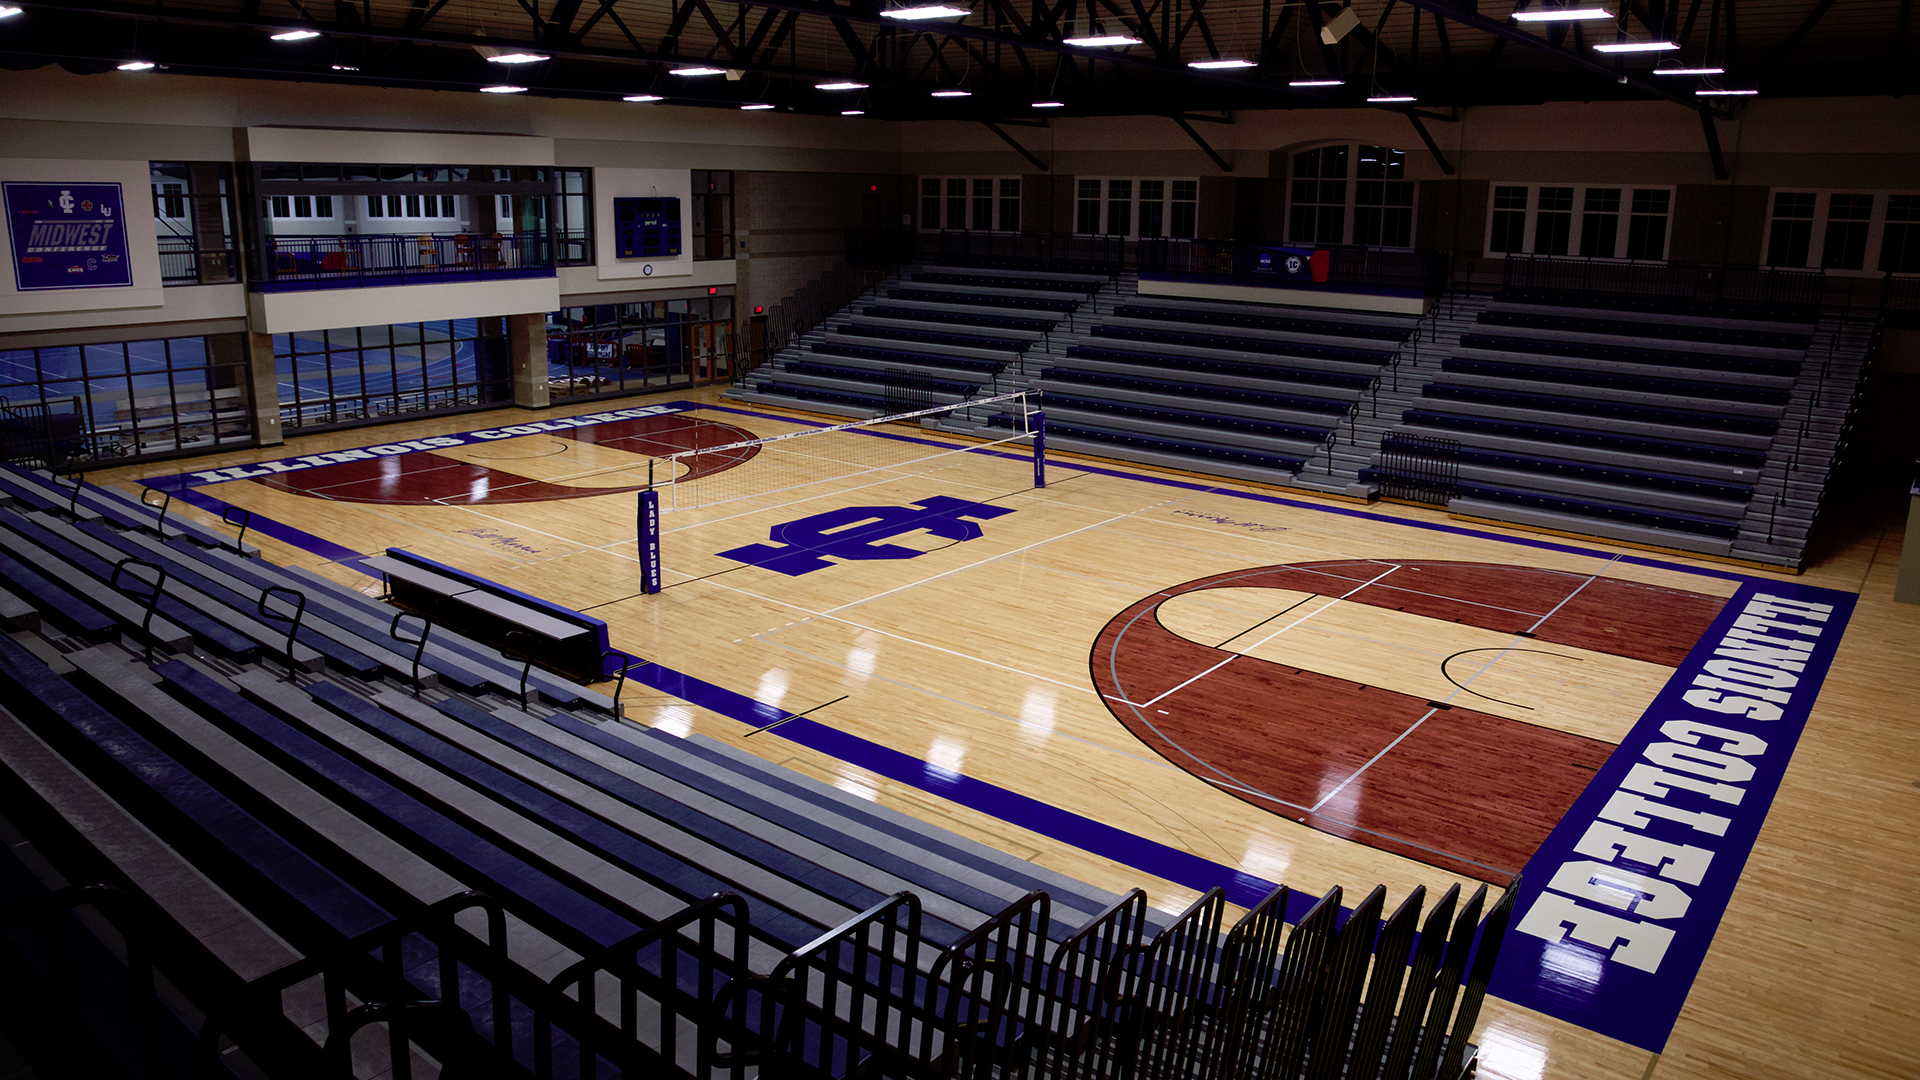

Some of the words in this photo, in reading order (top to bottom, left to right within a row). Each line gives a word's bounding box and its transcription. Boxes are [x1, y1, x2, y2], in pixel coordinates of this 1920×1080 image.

[28, 223, 113, 246] MIDWEST
[1289, 260, 1299, 269] IC
[190, 435, 466, 483] ILLINOIS
[470, 405, 683, 439] COLLEGE
[649, 543, 658, 586] BLUES
[1682, 592, 1834, 721] ILLINOIS
[1515, 719, 1768, 974] COLLEGE
